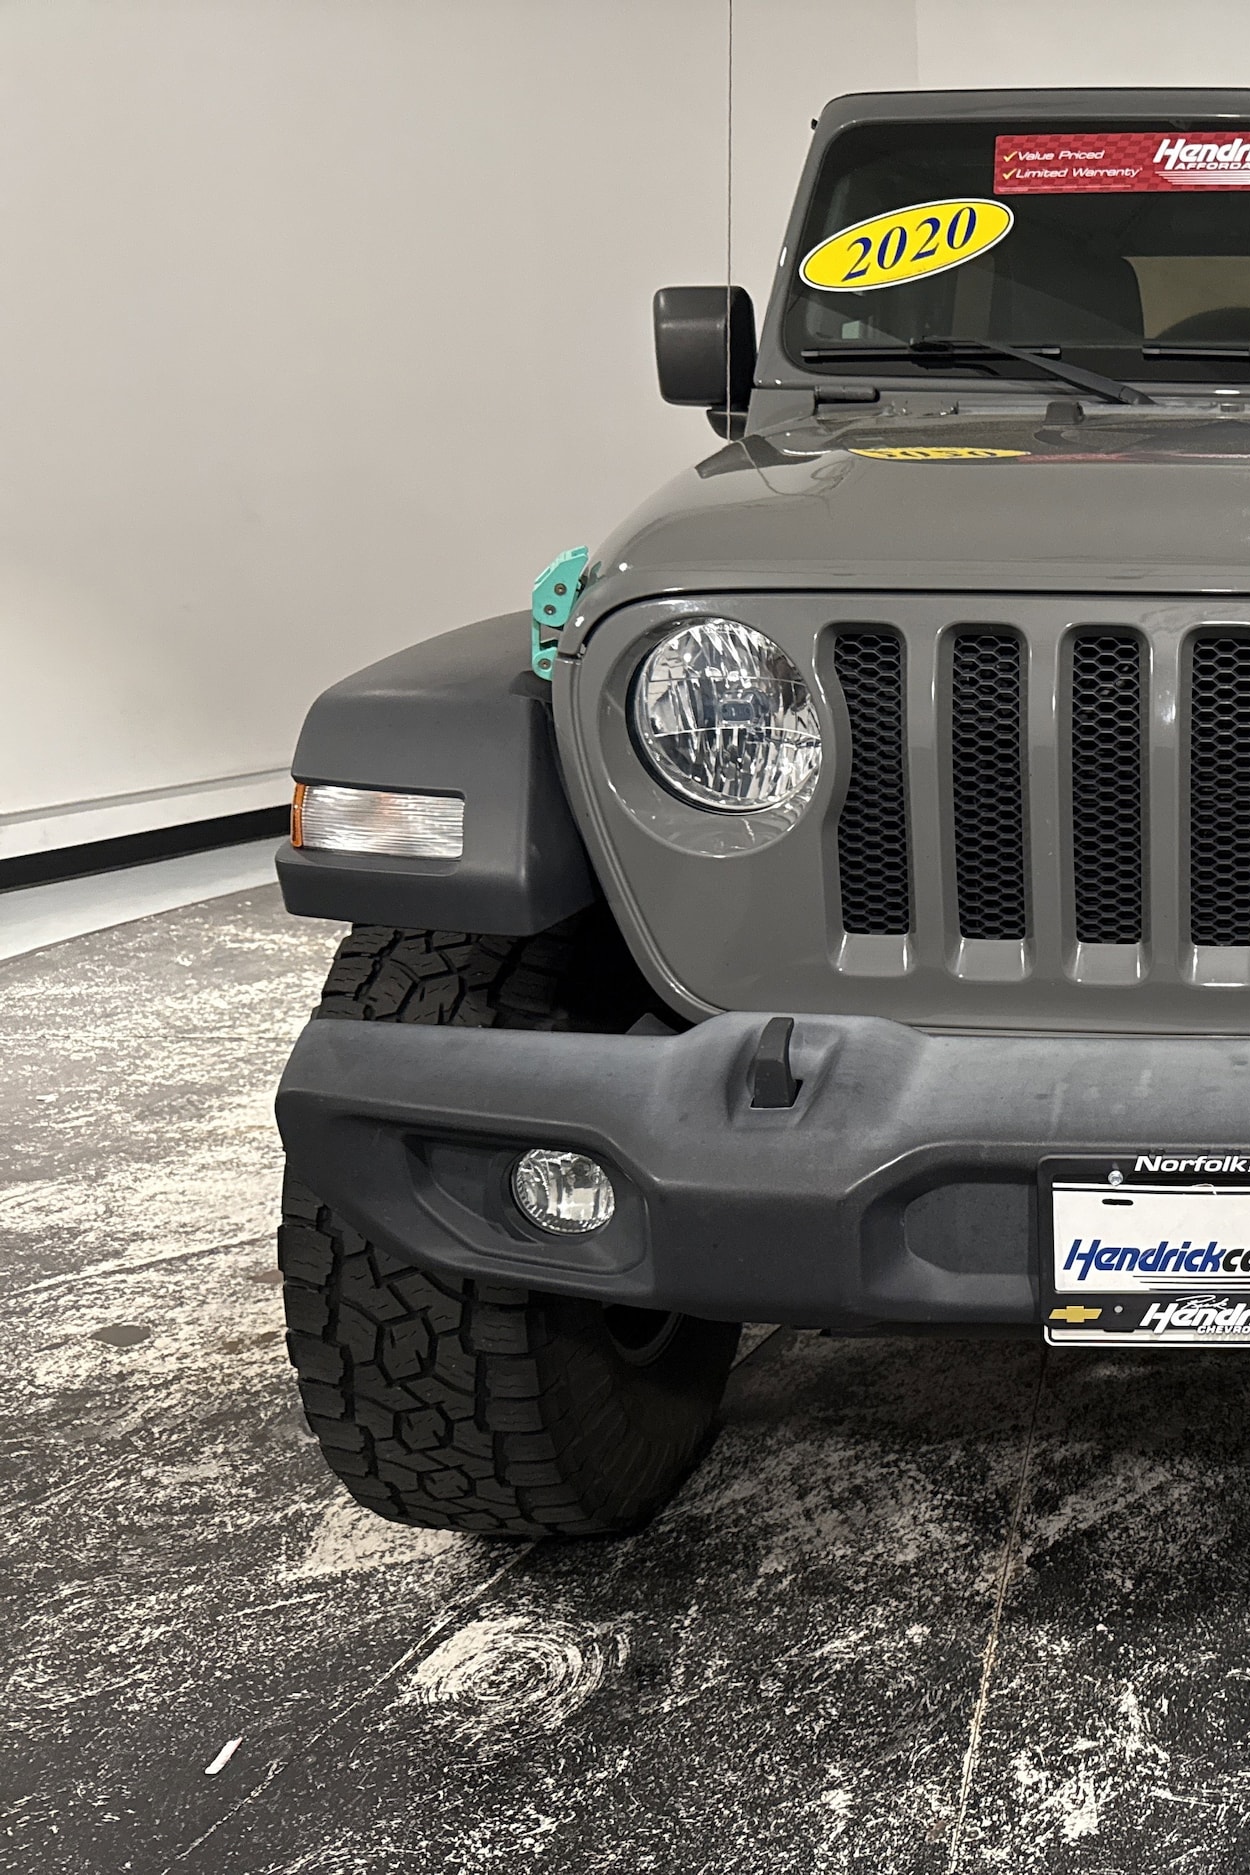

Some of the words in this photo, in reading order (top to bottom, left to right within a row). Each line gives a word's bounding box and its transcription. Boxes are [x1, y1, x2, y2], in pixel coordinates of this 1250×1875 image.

[1018, 151, 1055, 161] Value
[1059, 150, 1105, 160] Priced
[1015, 168, 1069, 179] Limited
[841, 207, 976, 282] 2020
